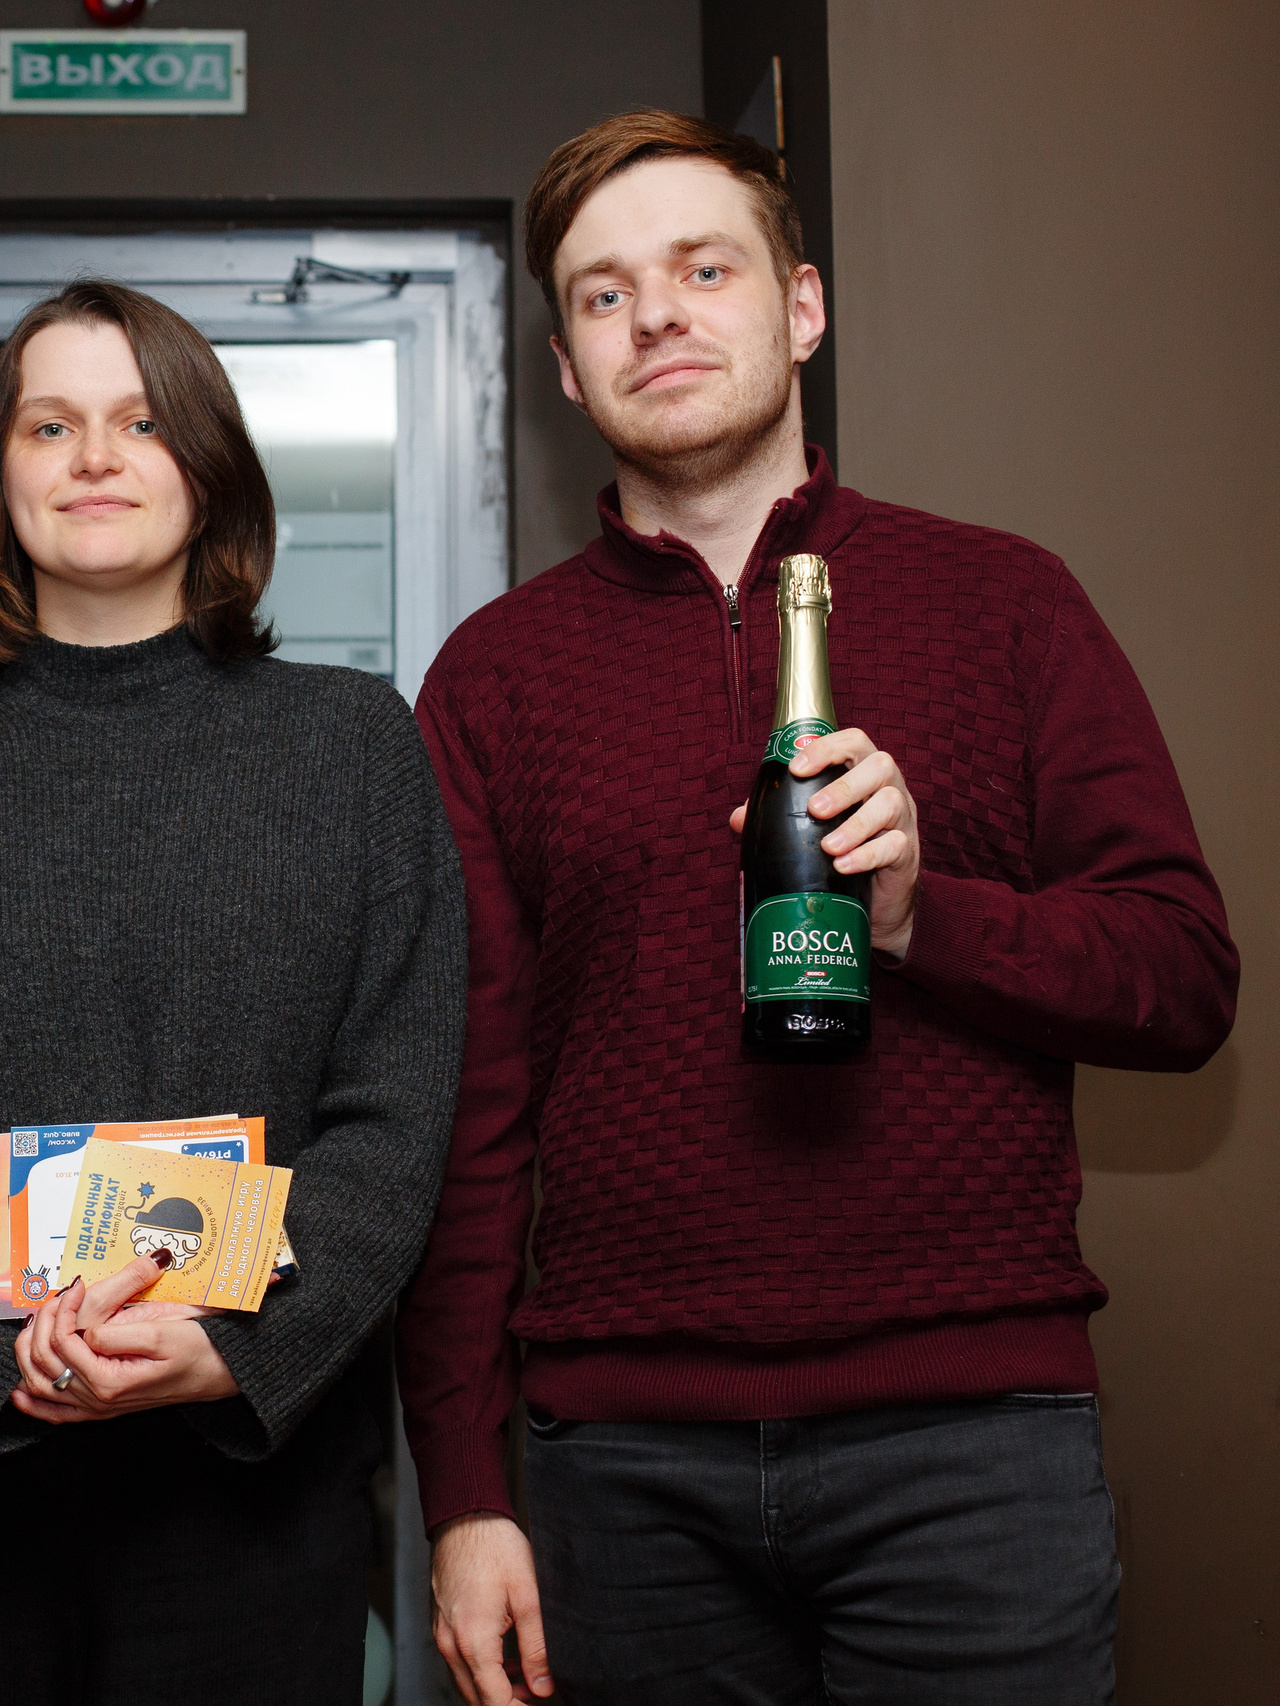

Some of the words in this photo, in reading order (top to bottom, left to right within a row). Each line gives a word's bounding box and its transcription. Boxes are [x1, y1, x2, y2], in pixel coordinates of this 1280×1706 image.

[19, 54, 227, 91] ВЫХОД
[772, 930, 855, 953] BOSCA
[768, 955, 802, 966] ANNA
[807, 955, 858, 967] FEDERICA
[794, 976, 834, 985] Limited
[186, 1128, 246, 1136] Предварительная
[197, 1196, 213, 1216] квиза
[237, 1181, 251, 1206] игру
[75, 1173, 104, 1260] ПОДАРОЧНЫЙ
[92, 1177, 120, 1260] СЕРТИФИКАТ
[109, 1190, 127, 1248] vk.com/bigquiz
[203, 1217, 218, 1256] большого
[219, 1210, 243, 1277] бесплатную
[229, 1279, 241, 1297] для
[236, 1236, 252, 1275] одного
[246, 1179, 264, 1233] человека
[182, 1257, 208, 1277] теория
[216, 1280, 227, 1292] на
